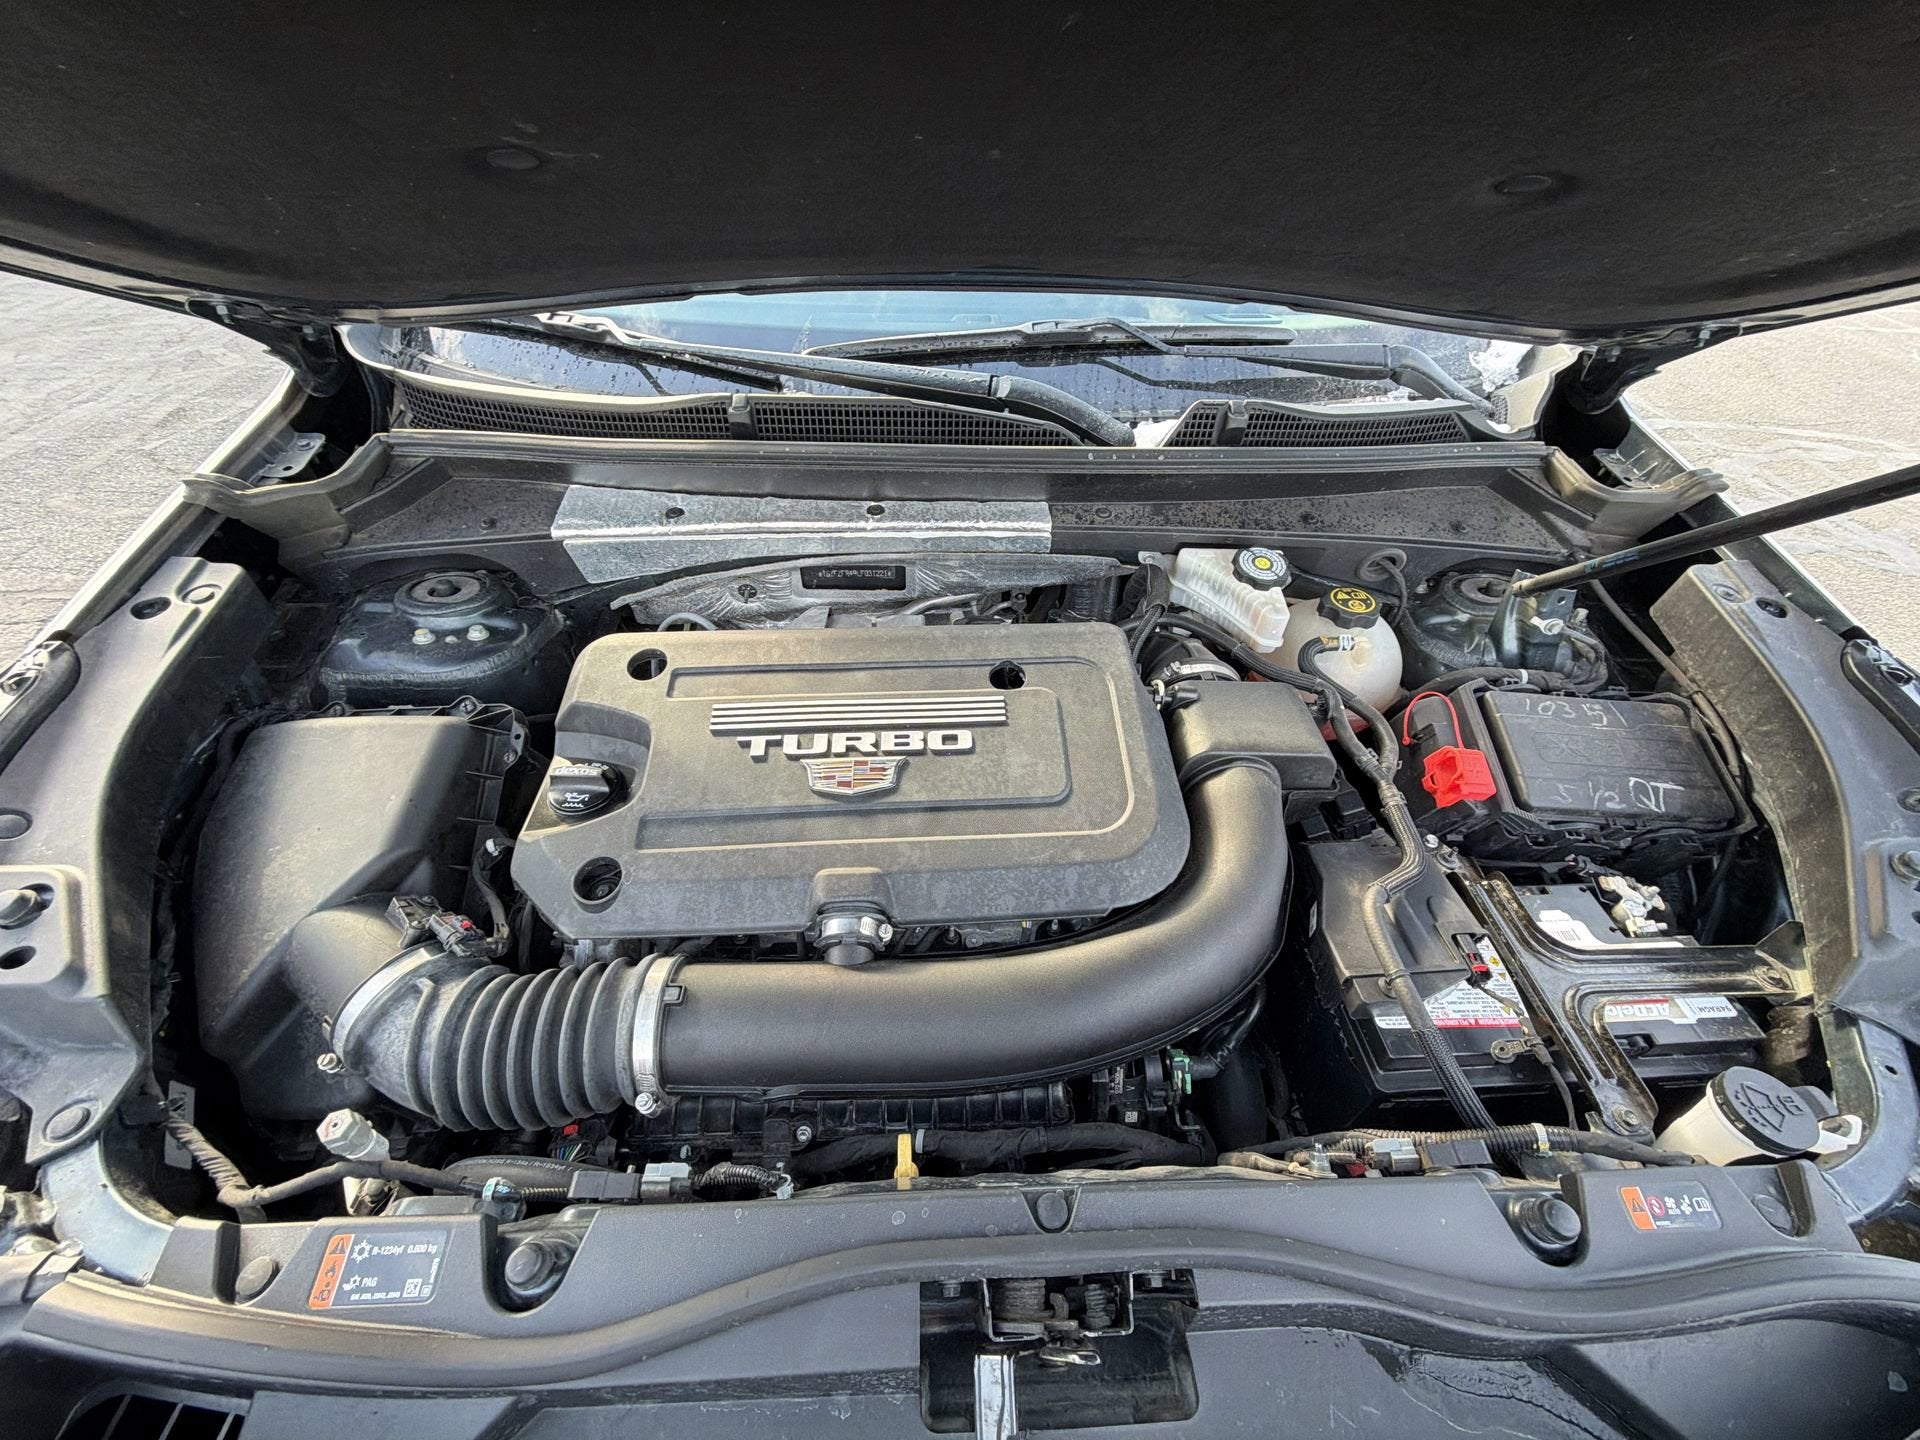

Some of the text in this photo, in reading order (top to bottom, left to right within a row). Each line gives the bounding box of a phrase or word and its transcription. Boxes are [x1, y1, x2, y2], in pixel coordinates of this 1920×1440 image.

[736, 729, 974, 757] TURBO
[554, 767, 598, 776] dexos
[1628, 776, 1686, 814] QT
[1606, 1003, 1669, 1017] ACDelc
[372, 1246, 404, 1256] R-1234yf
[428, 1244, 438, 1255] kg
[361, 1277, 378, 1288] PAG
